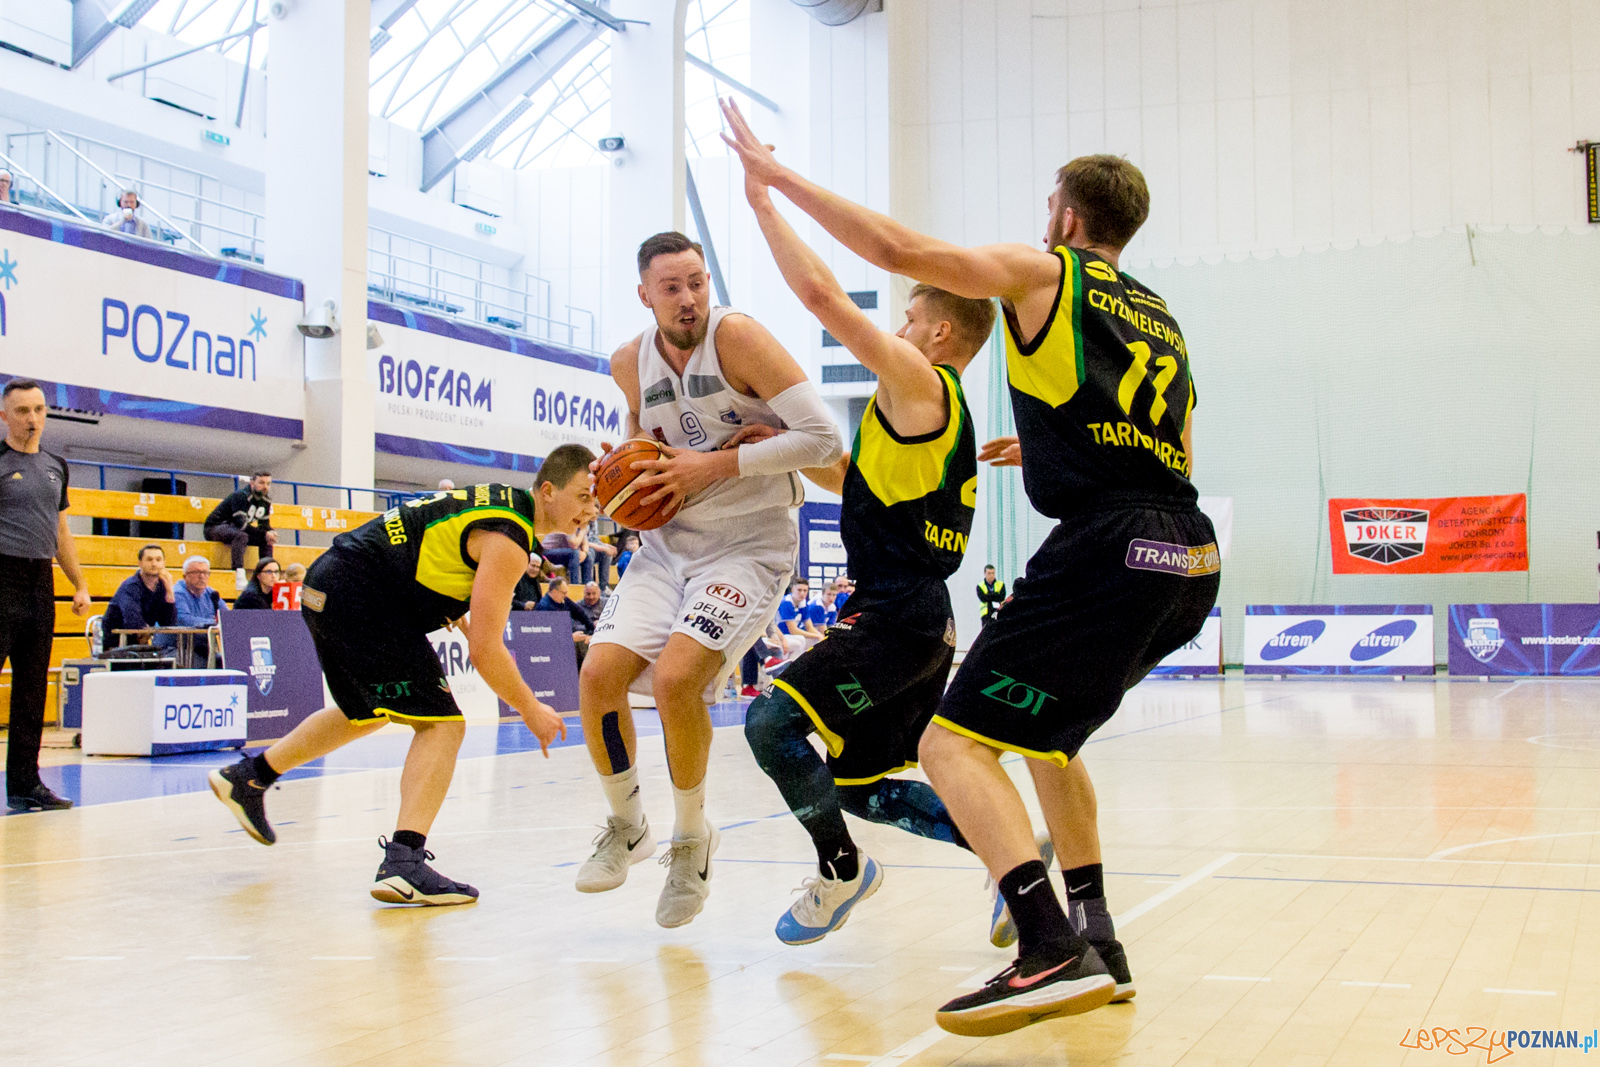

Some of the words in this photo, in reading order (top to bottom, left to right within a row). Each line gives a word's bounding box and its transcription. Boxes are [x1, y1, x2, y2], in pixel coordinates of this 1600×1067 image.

[378, 355, 492, 413] BIOFARM
[388, 403, 414, 417] POLSKI
[415, 408, 457, 425] PRODUCENT
[533, 387, 620, 436] BIOFARM
[680, 411, 707, 447] 9
[605, 465, 621, 482] FIBA
[1357, 510, 1413, 520] SECURITY
[1461, 506, 1501, 515] AGENCJA
[1438, 516, 1526, 528] DETEKTYWISTYCZNA
[1357, 525, 1417, 541] JOKER
[1463, 529, 1506, 539] OCHRONY
[1449, 542, 1477, 550] JOKER
[1440, 551, 1526, 562] www.joker-security.pl
[712, 586, 740, 604] KIA
[693, 601, 734, 625] DELIK
[691, 615, 724, 641] PBG
[1269, 632, 1314, 648] atrem
[1359, 632, 1404, 648] atrem
